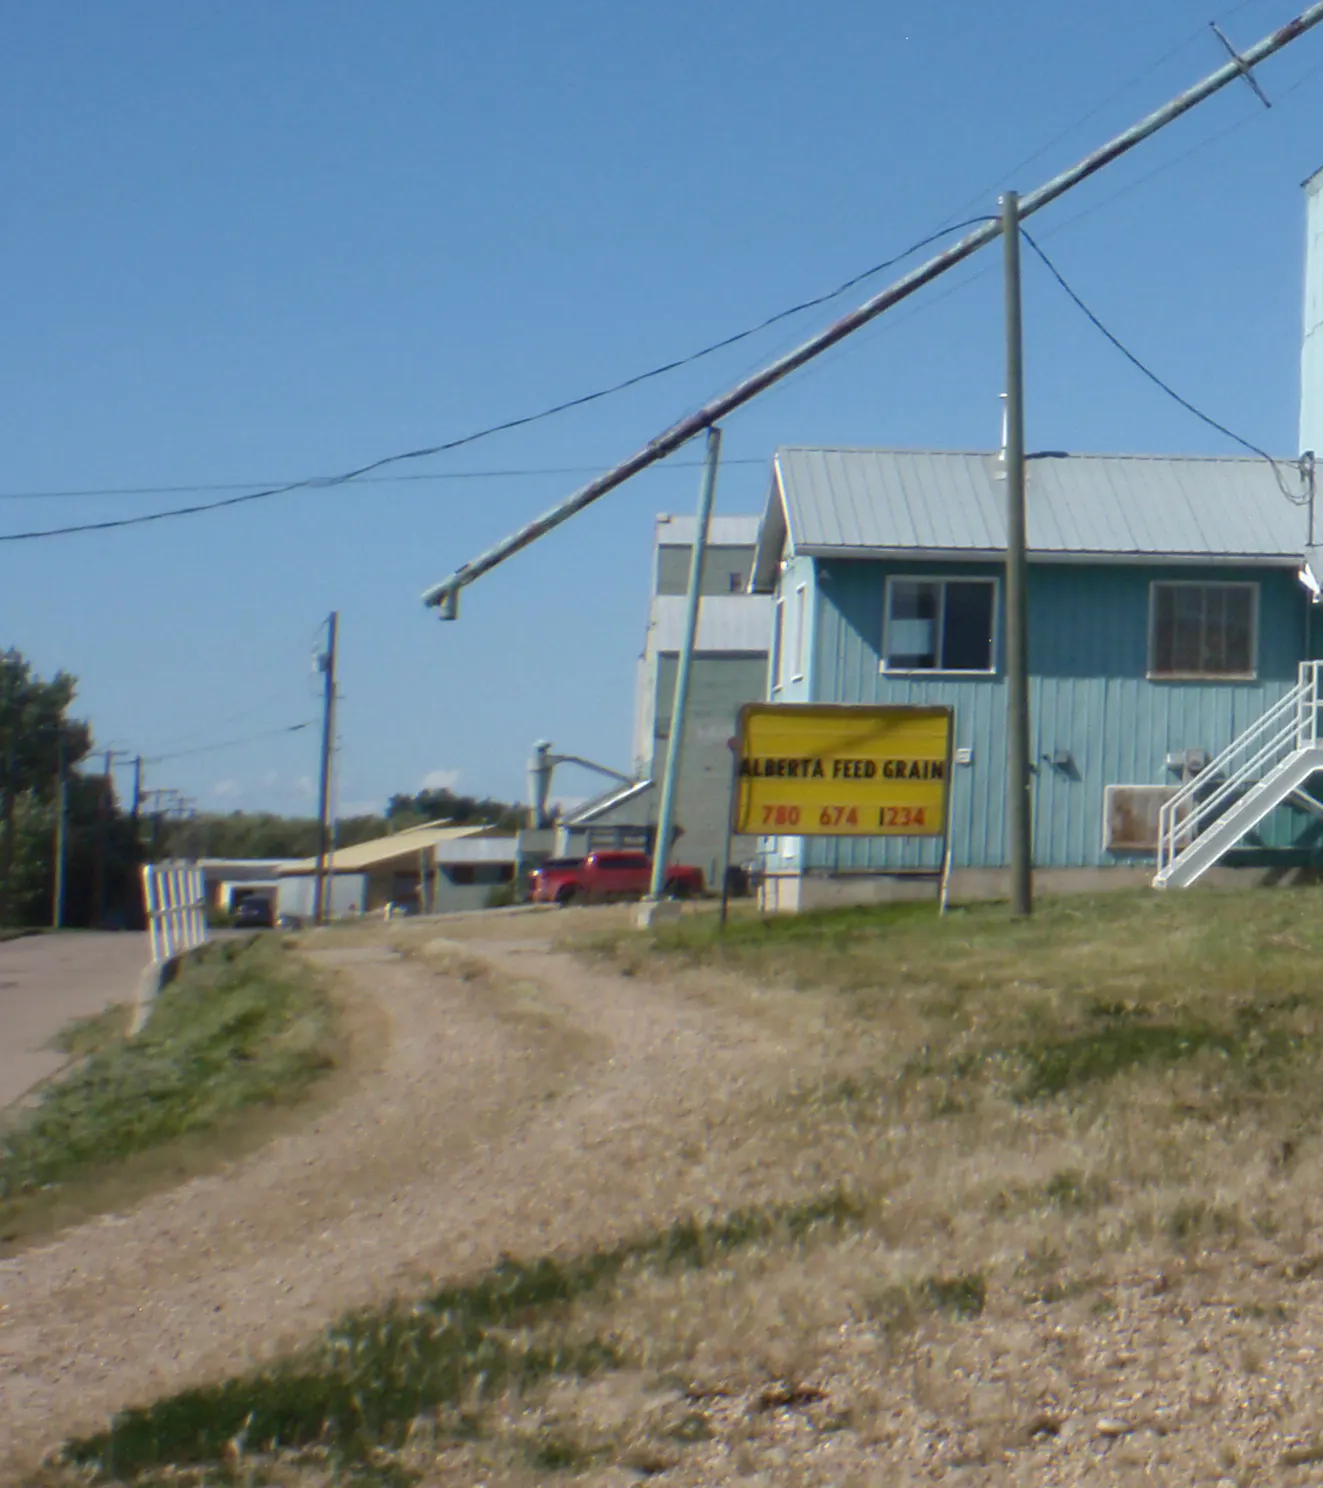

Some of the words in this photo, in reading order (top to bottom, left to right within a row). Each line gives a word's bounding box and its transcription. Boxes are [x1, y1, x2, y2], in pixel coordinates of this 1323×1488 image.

[740, 759, 824, 779] ALBERTA
[833, 760, 876, 779] FEED
[883, 760, 944, 780] GRAIN
[762, 806, 801, 825] 780
[820, 807, 858, 826] 674
[879, 807, 925, 827] 1234
